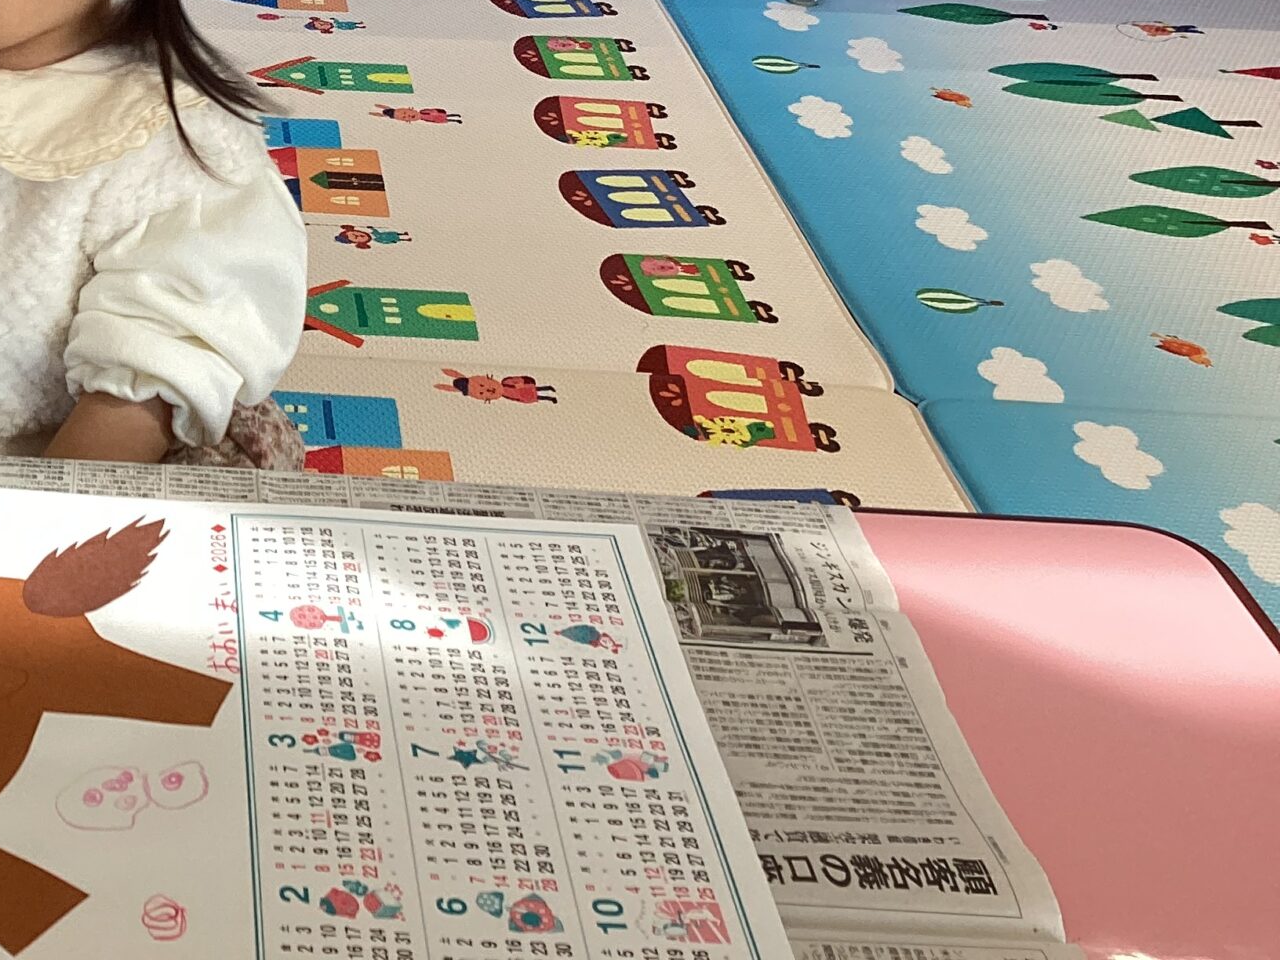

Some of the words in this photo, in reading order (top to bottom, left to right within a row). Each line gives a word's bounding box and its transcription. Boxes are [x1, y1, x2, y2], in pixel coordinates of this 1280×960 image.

[211, 534, 227, 563] 2026
[259, 609, 283, 623] 4
[389, 618, 416, 632] 8
[521, 623, 548, 645] 12
[269, 735, 296, 747] 3
[410, 742, 440, 758] 7
[553, 748, 586, 774] 11
[282, 764, 298, 773] 7
[305, 764, 320, 777] 14
[328, 767, 343, 779] 21
[350, 768, 366, 781] 28
[284, 781, 299, 789] 6
[306, 780, 322, 793] 13
[451, 775, 467, 787] 13
[474, 776, 491, 790] 20
[496, 777, 513, 791] 27
[329, 781, 345, 795] 20
[352, 782, 368, 796] 27
[598, 785, 614, 797] 10
[620, 786, 637, 799] 17
[643, 788, 661, 801] 24
[285, 796, 301, 804] 5
[308, 795, 324, 808] 12
[432, 791, 447, 799] 5
[454, 789, 470, 803] 12
[477, 791, 493, 804] 19
[500, 793, 517, 807] 26
[667, 791, 684, 802] 31
[331, 797, 347, 809] 19
[354, 799, 370, 812] 26
[580, 801, 596, 809] 2
[603, 803, 619, 811] 9
[625, 801, 642, 814] 16
[434, 807, 450, 815] 4
[457, 807, 473, 819] 11
[480, 807, 496, 820] 18
[503, 809, 520, 823] 25
[648, 803, 666, 817] 23
[671, 805, 689, 818] 30
[287, 813, 302, 821] 4
[310, 812, 325, 825] 11
[332, 813, 348, 826] 18
[355, 815, 372, 829] 25
[607, 818, 623, 826] 8
[629, 817, 646, 830] 15
[437, 823, 453, 831] 3
[460, 822, 477, 835] 10
[483, 823, 500, 837] 17
[653, 818, 671, 832] 22
[676, 820, 694, 834] 29
[288, 829, 304, 838] 3
[311, 828, 327, 842] 10
[334, 829, 350, 843] 17
[358, 832, 374, 845] 24
[506, 825, 524, 839] 24
[611, 834, 628, 843] 7
[440, 839, 456, 849] 2
[463, 842, 479, 850] 9
[634, 833, 651, 847] 14
[659, 836, 676, 849] 21
[681, 836, 700, 850] 28
[289, 845, 305, 854] 2
[313, 847, 329, 855] 9
[336, 845, 352, 859] 16
[486, 840, 503, 854] 16
[510, 842, 527, 857] 23
[533, 844, 551, 858] 30
[359, 847, 376, 862] 23
[616, 852, 632, 860] 6
[639, 850, 656, 864] 13
[663, 852, 681, 866] 20
[686, 852, 705, 867] 27
[290, 863, 306, 871] 1
[314, 864, 330, 873] 8
[466, 858, 482, 866] 8
[489, 857, 506, 870] 15
[513, 858, 531, 873] 22
[537, 860, 555, 875] 29
[337, 863, 355, 877] 15
[361, 864, 379, 879] 22
[620, 868, 637, 877] 5
[643, 866, 661, 881] 12
[668, 868, 685, 882] 19
[691, 869, 710, 883] 26
[757, 852, 999, 896] 顧客名義の口座
[469, 875, 485, 885] 7
[493, 874, 510, 888] 14
[517, 877, 534, 892] 21
[540, 878, 559, 893] 28
[280, 887, 310, 903] 2
[625, 886, 640, 895] 4
[649, 885, 667, 898] 11
[673, 886, 690, 900] 18
[697, 887, 716, 901] 25
[437, 898, 467, 914] 6
[593, 900, 627, 933] 10
